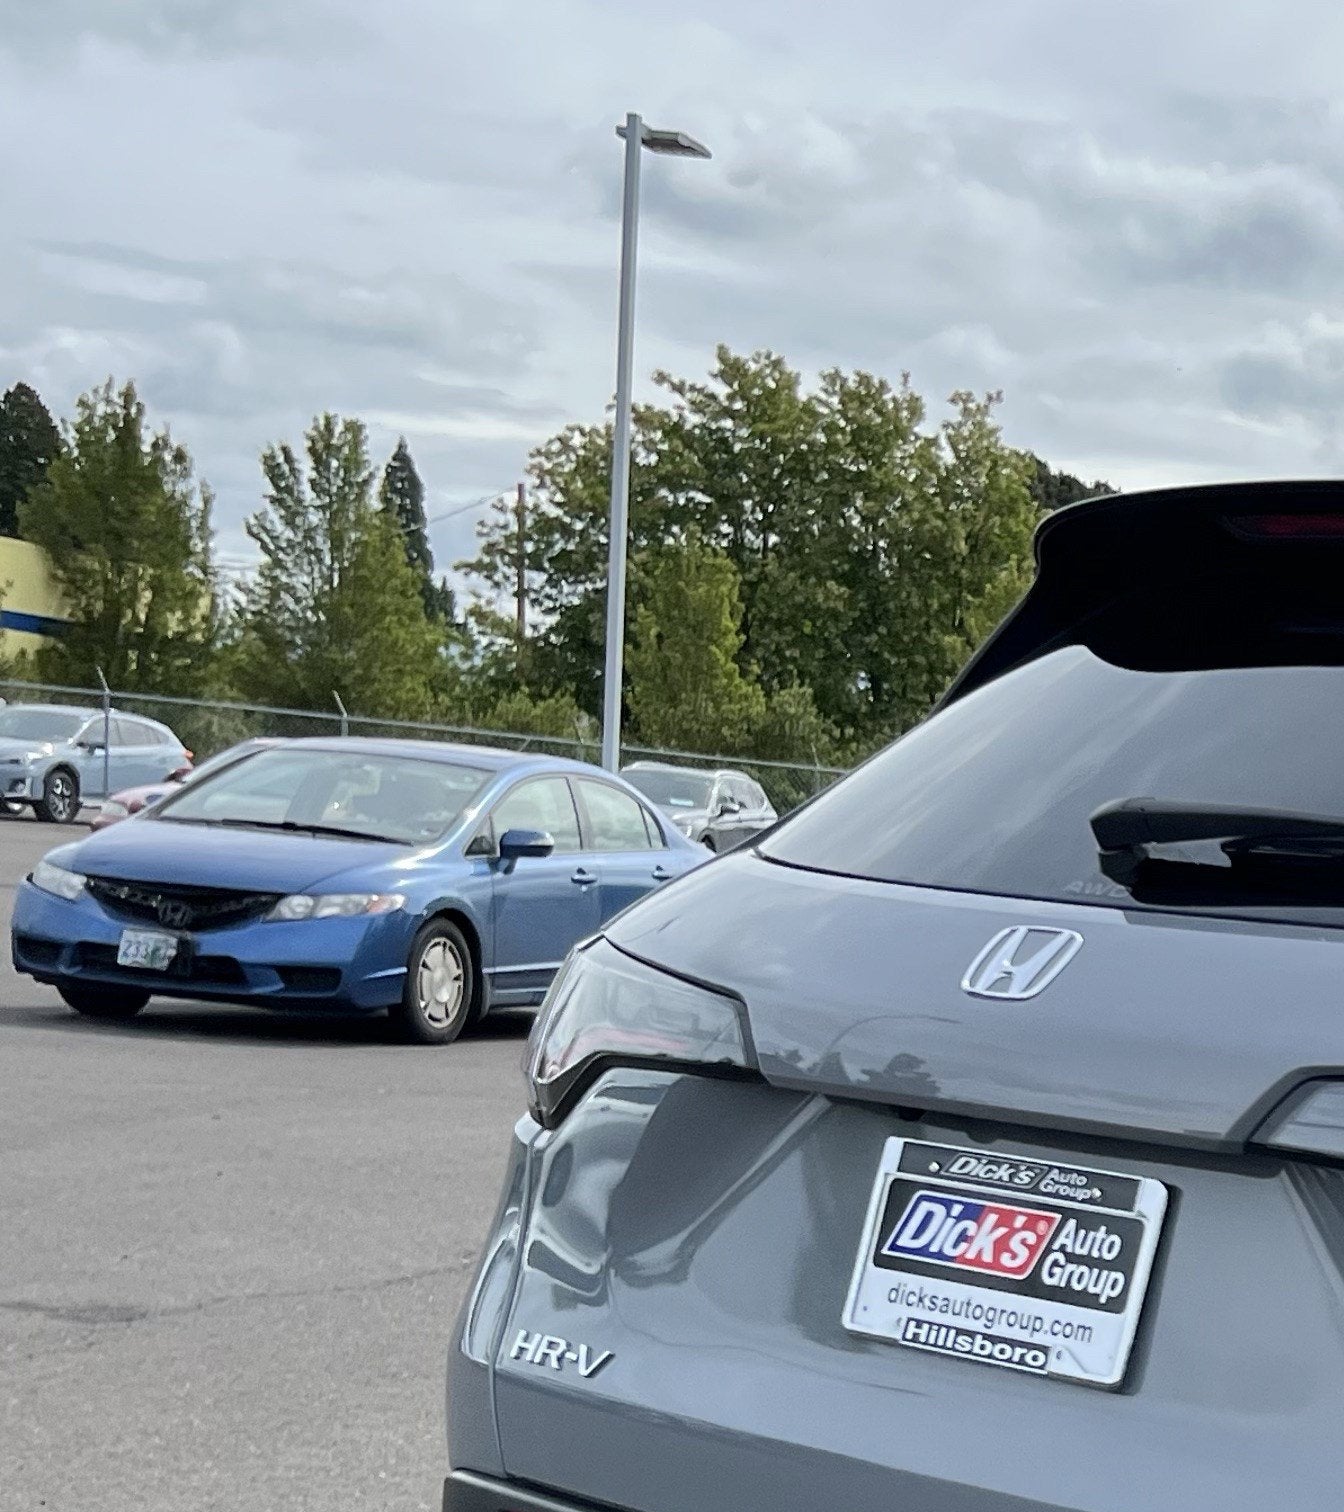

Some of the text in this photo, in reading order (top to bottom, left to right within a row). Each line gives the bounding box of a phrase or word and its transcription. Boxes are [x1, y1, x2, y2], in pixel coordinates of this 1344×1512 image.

[950, 1156, 1088, 1187] Dick's Auto
[1039, 1179, 1093, 1201] Group
[895, 1200, 1122, 1269] Dick's Auto
[1041, 1252, 1126, 1304] Group
[886, 1282, 1093, 1343] dicksautogroup.com
[510, 1329, 614, 1377] HR-V
[903, 1318, 1047, 1367] Hillsboro
